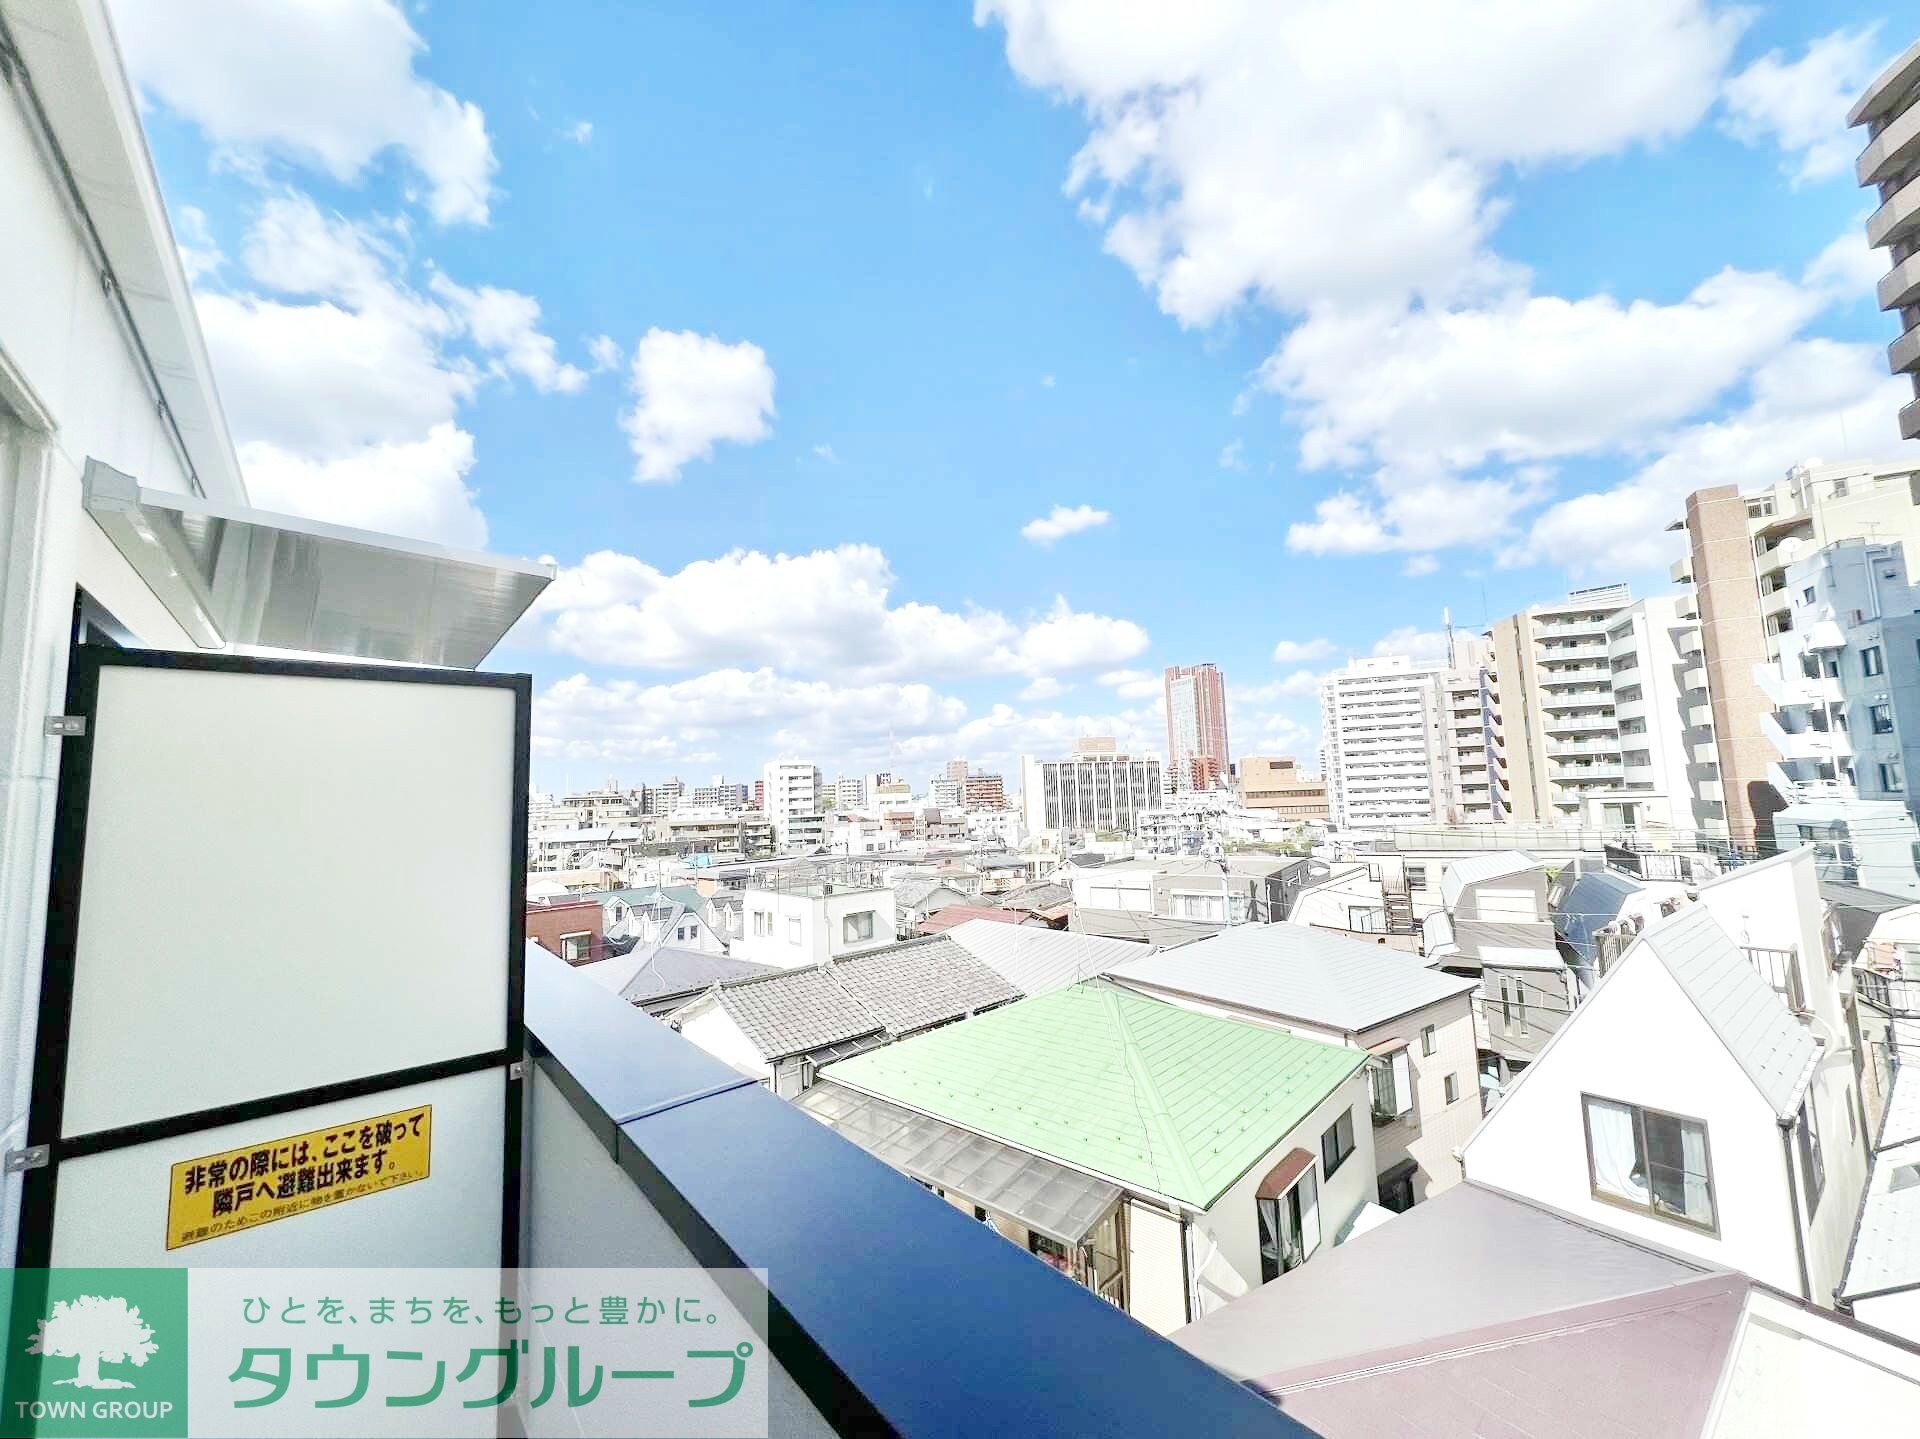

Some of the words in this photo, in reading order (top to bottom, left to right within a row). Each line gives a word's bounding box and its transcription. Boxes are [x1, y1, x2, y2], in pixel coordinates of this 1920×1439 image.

[184, 1113, 424, 1195] 非常の際には、ここを破って
[212, 1148, 395, 1218] 隣戸へ避難出来ます。
